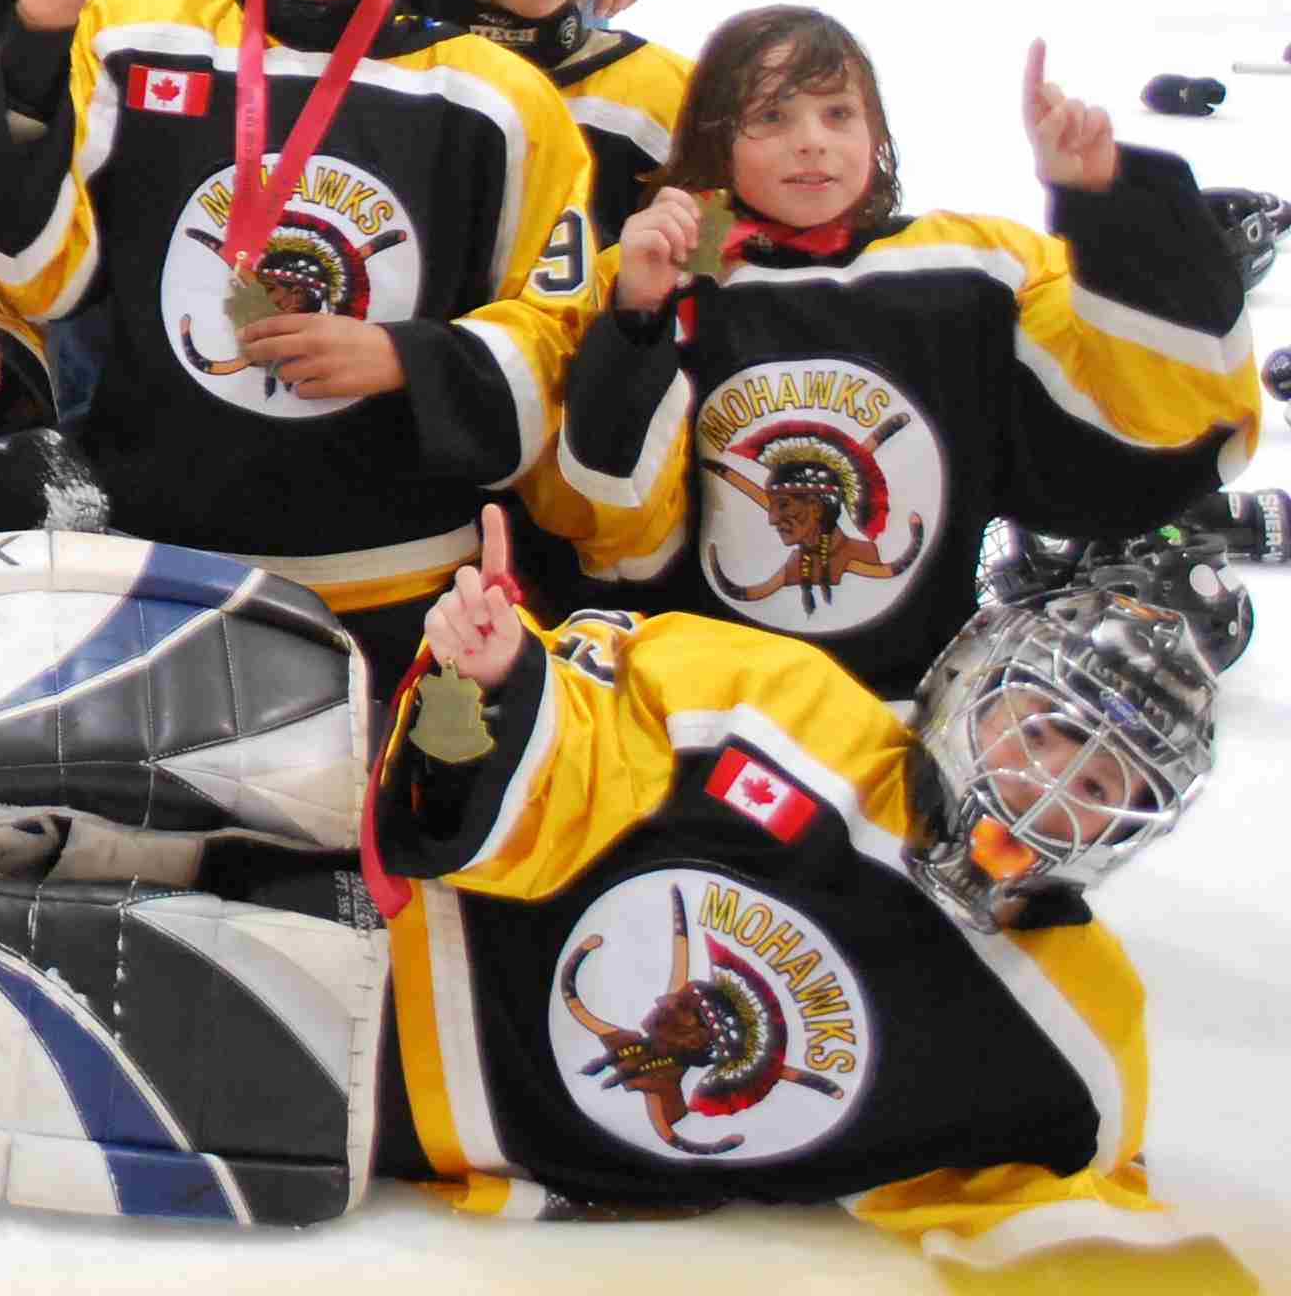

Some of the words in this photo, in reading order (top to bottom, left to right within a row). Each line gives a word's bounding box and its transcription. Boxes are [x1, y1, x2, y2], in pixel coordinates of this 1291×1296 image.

[531, 207, 590, 297] 9
[700, 371, 891, 452] MOHAWKS
[699, 882, 857, 1075] MOHAWKS
